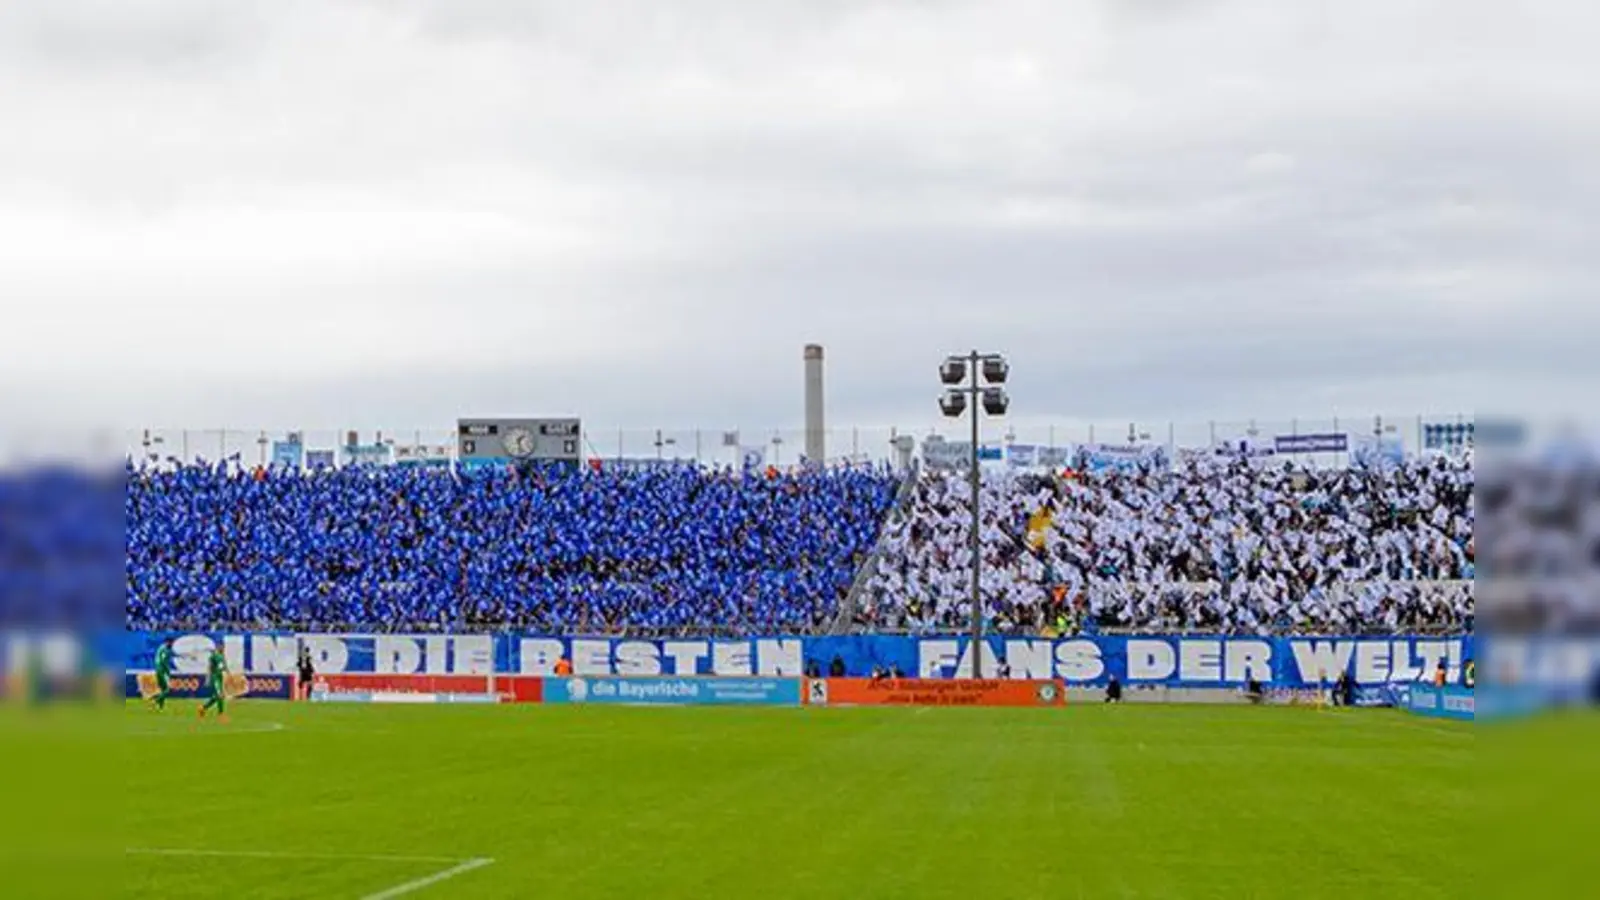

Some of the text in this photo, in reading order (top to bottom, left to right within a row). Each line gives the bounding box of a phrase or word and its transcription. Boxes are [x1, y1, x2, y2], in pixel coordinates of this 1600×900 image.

[172, 635, 1462, 683] SIND DIE BESTEN FANS DER WELT!
[593, 676, 699, 699] die Bayerische
